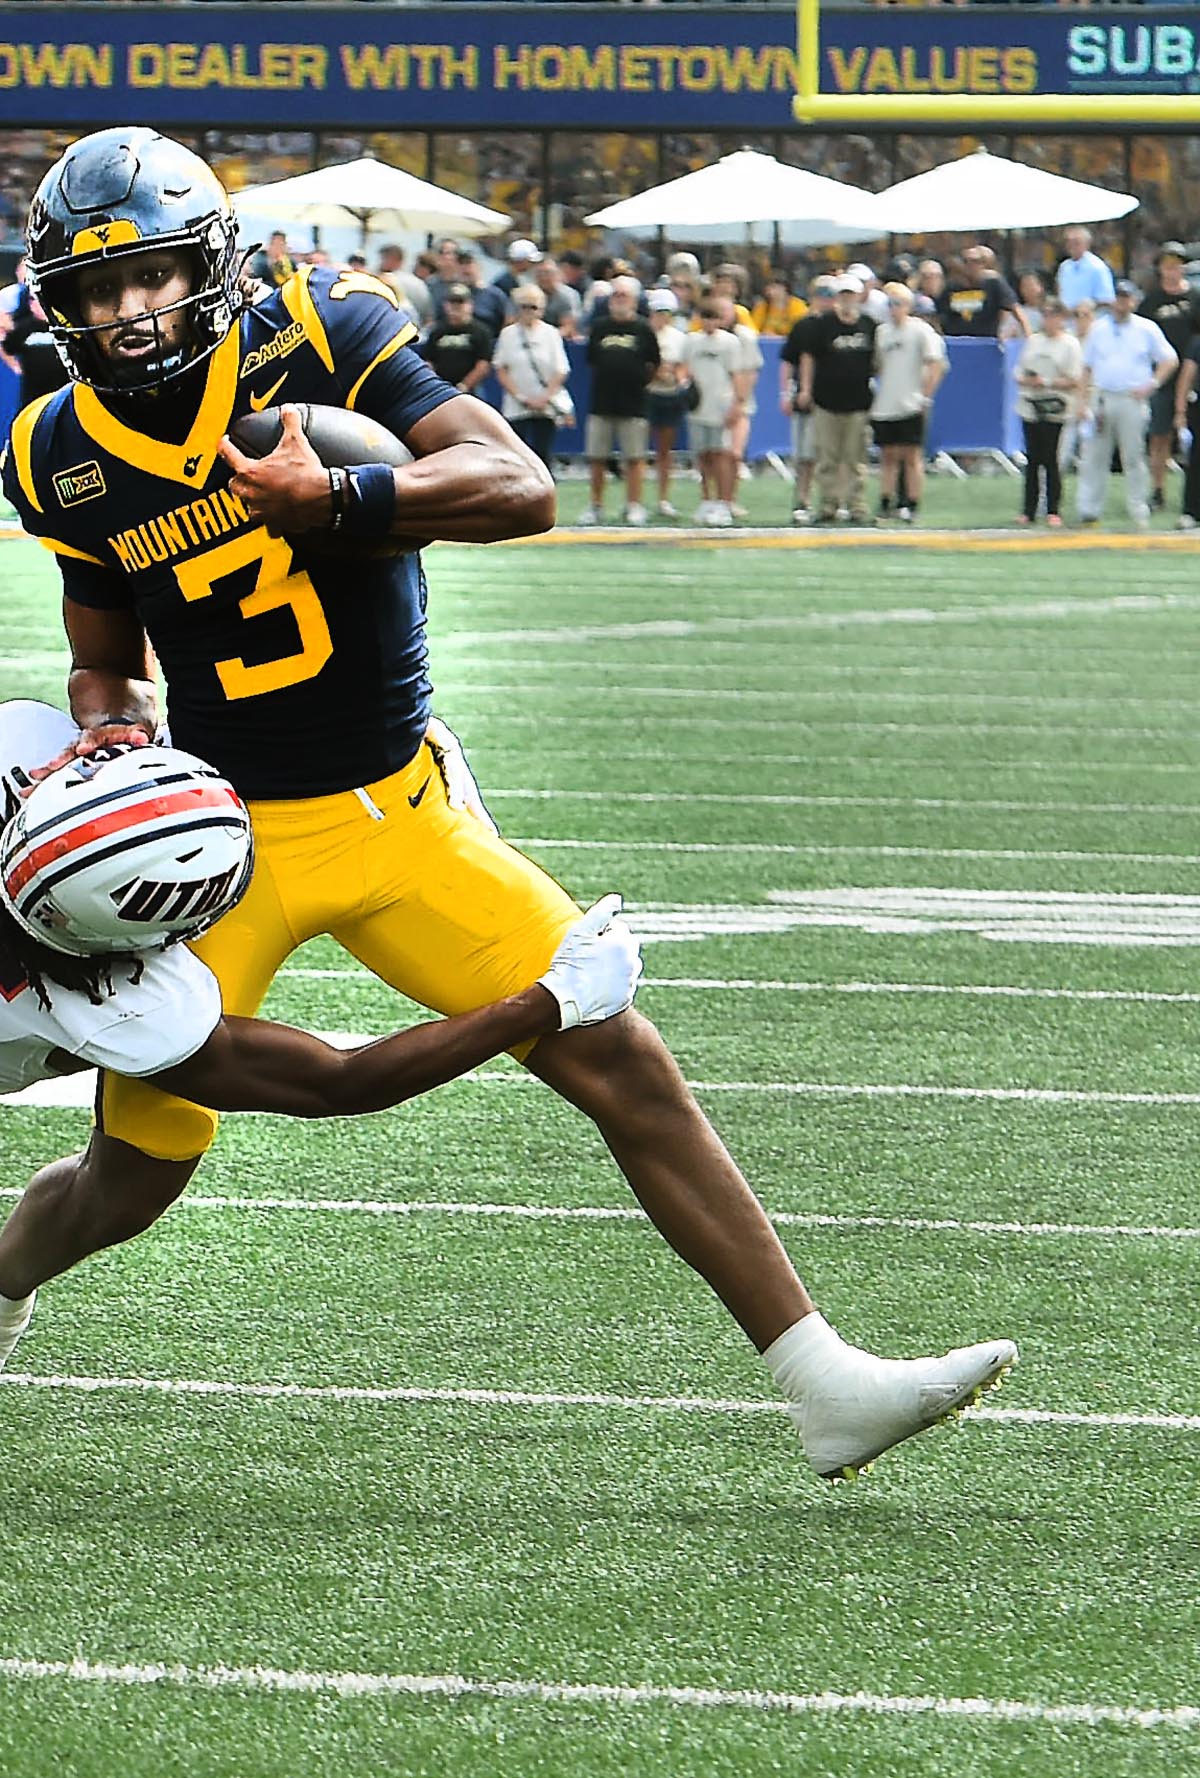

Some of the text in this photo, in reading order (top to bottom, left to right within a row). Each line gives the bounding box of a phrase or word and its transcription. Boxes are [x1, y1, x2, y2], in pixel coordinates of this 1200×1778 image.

[128, 43, 327, 90] DEALER
[340, 44, 478, 90] WITH
[493, 45, 800, 92] HOMETOWN
[827, 46, 1038, 92] VALUES
[1067, 25, 1200, 74] SUB
[107, 488, 250, 574] MOUNTAIN
[172, 524, 334, 701] 3
